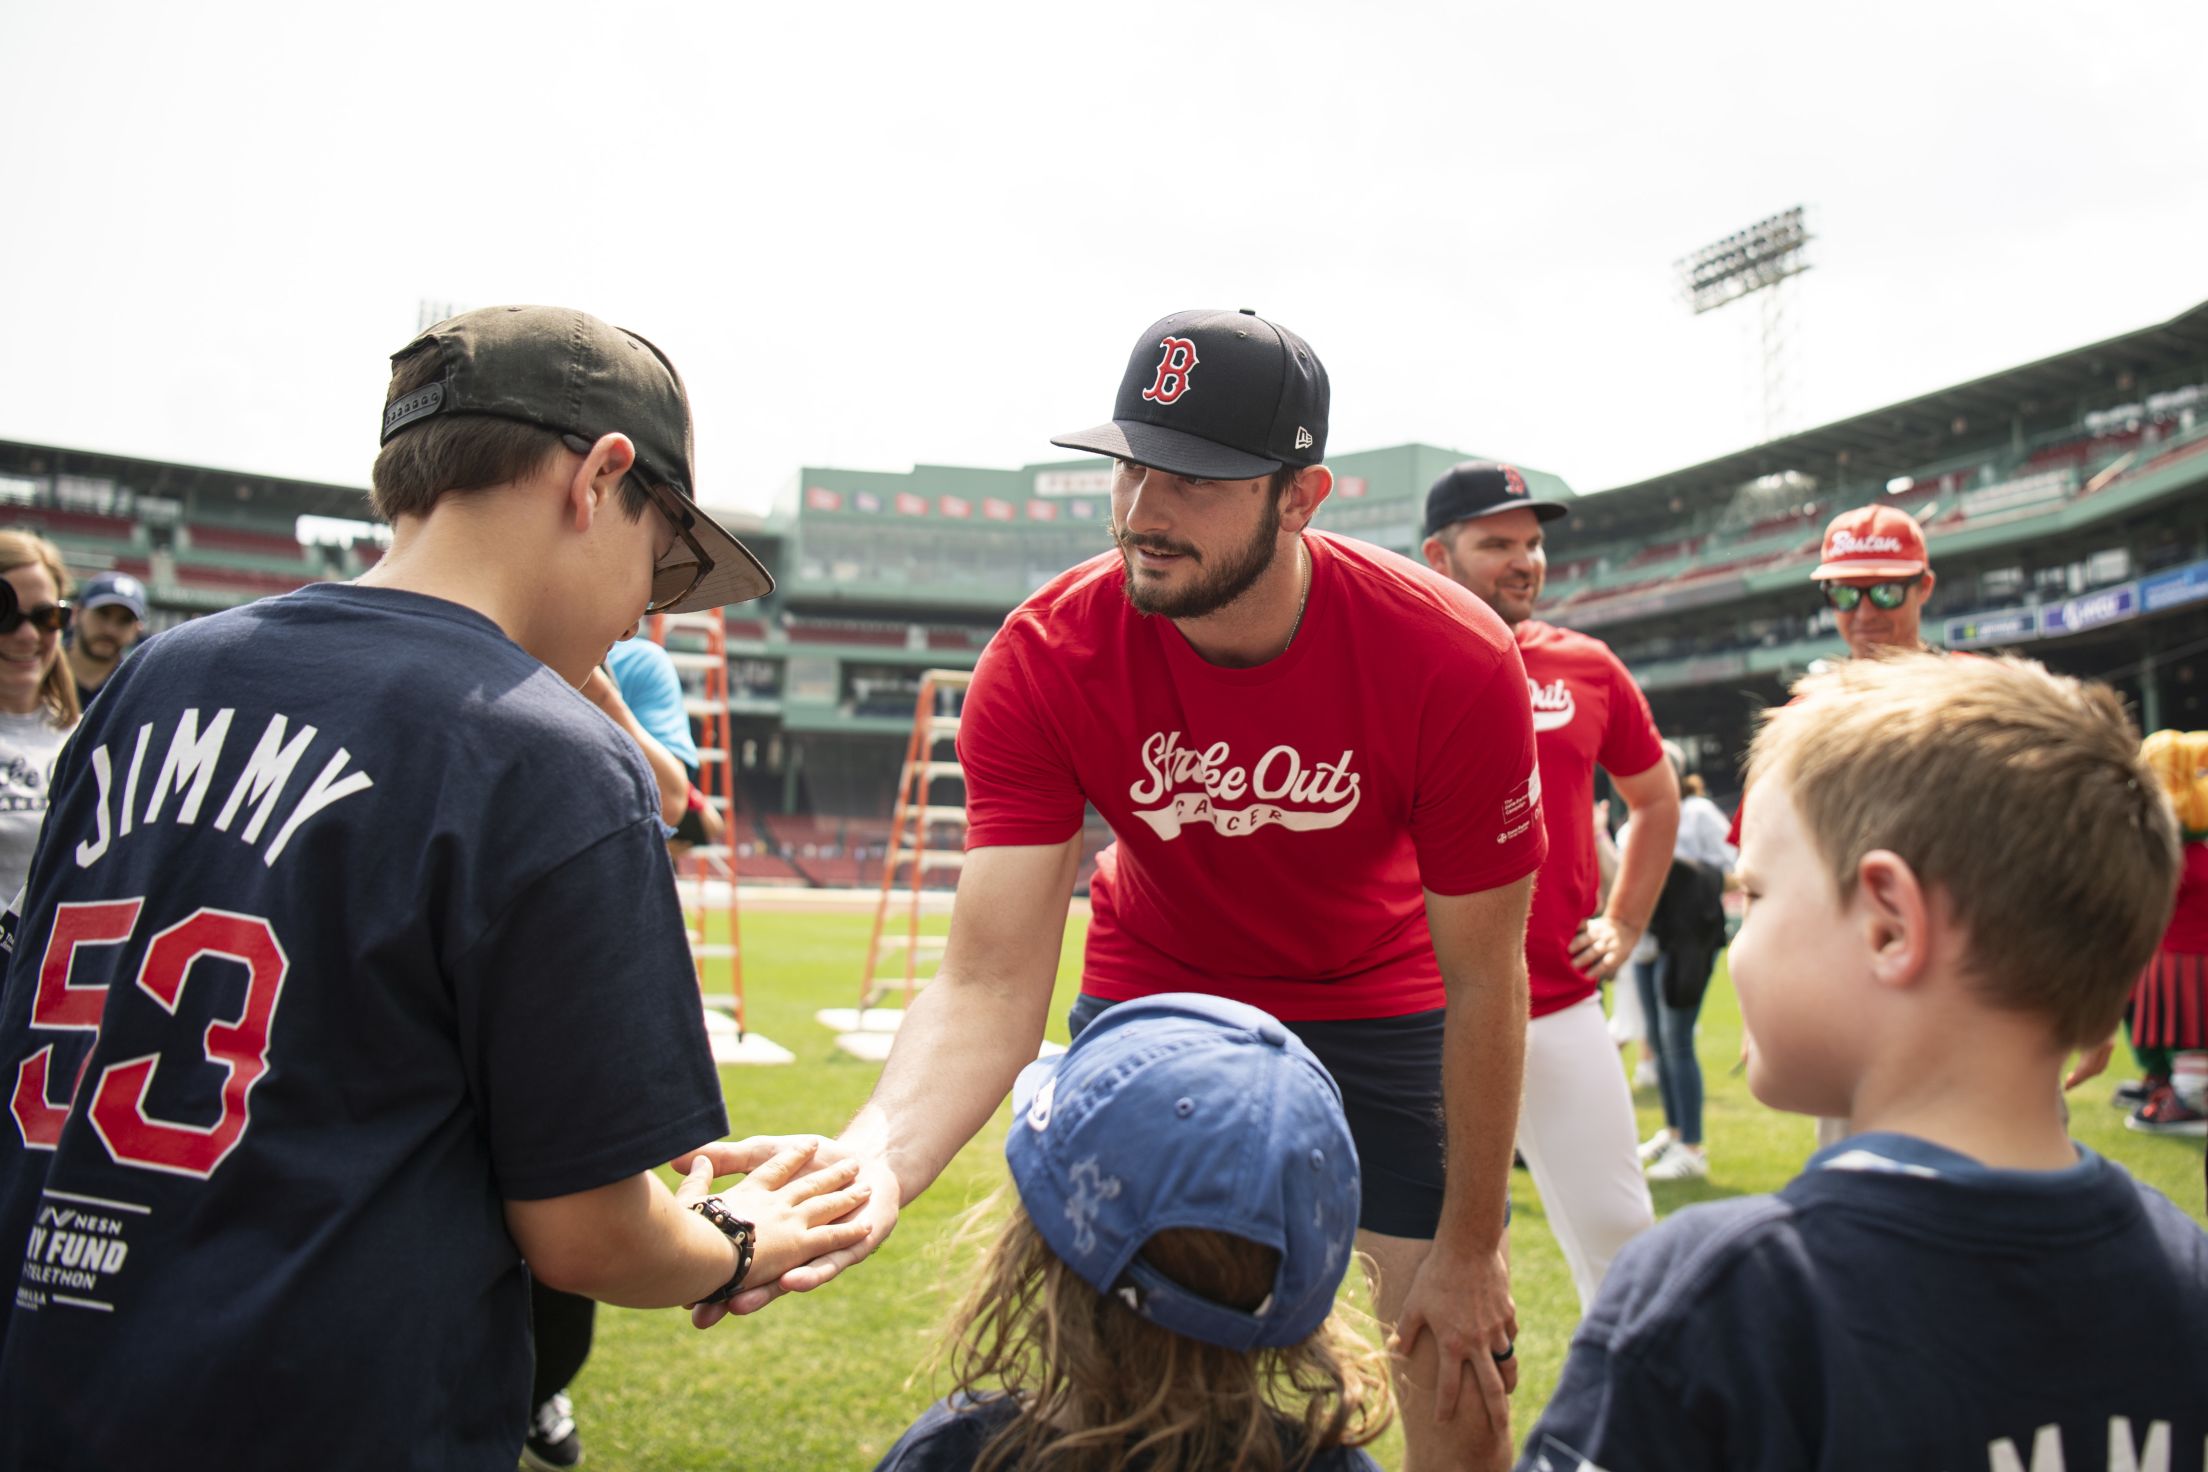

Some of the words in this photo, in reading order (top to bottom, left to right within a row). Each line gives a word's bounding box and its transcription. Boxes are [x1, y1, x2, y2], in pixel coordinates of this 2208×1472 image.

[1142, 336, 1200, 405] B
[76, 708, 374, 868] JIMMY
[1253, 744, 1360, 804] Out
[1175, 800, 1282, 831] CACER
[10, 896, 290, 1180] 53
[46, 1230, 128, 1274] FUND
[74, 1213, 122, 1235] NESN
